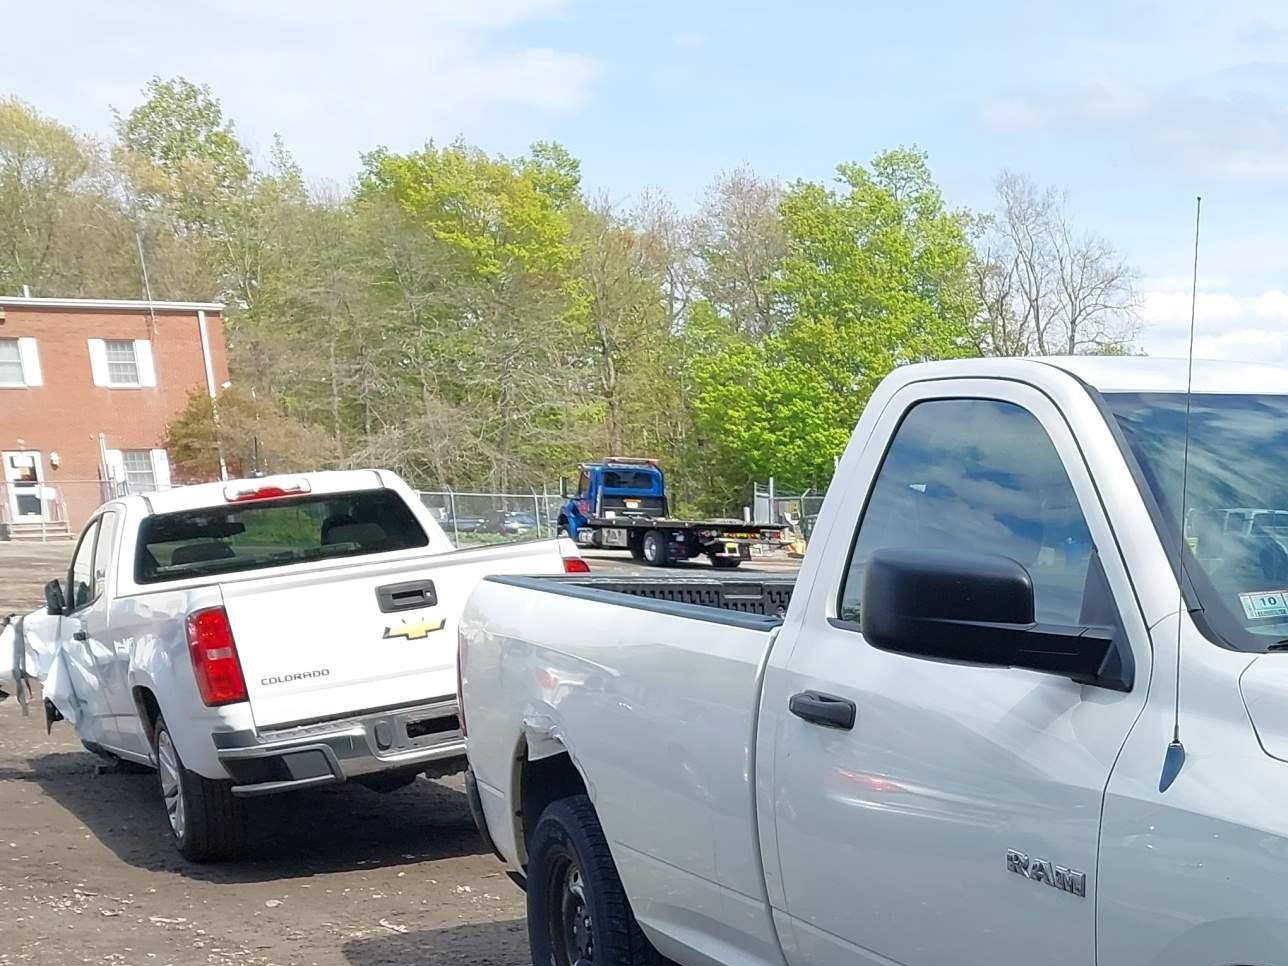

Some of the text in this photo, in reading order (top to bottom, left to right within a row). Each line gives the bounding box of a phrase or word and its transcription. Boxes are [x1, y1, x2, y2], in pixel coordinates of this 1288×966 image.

[1260, 597, 1277, 607] 10
[261, 669, 330, 686] COLORADO
[1006, 848, 1087, 898] RAM
